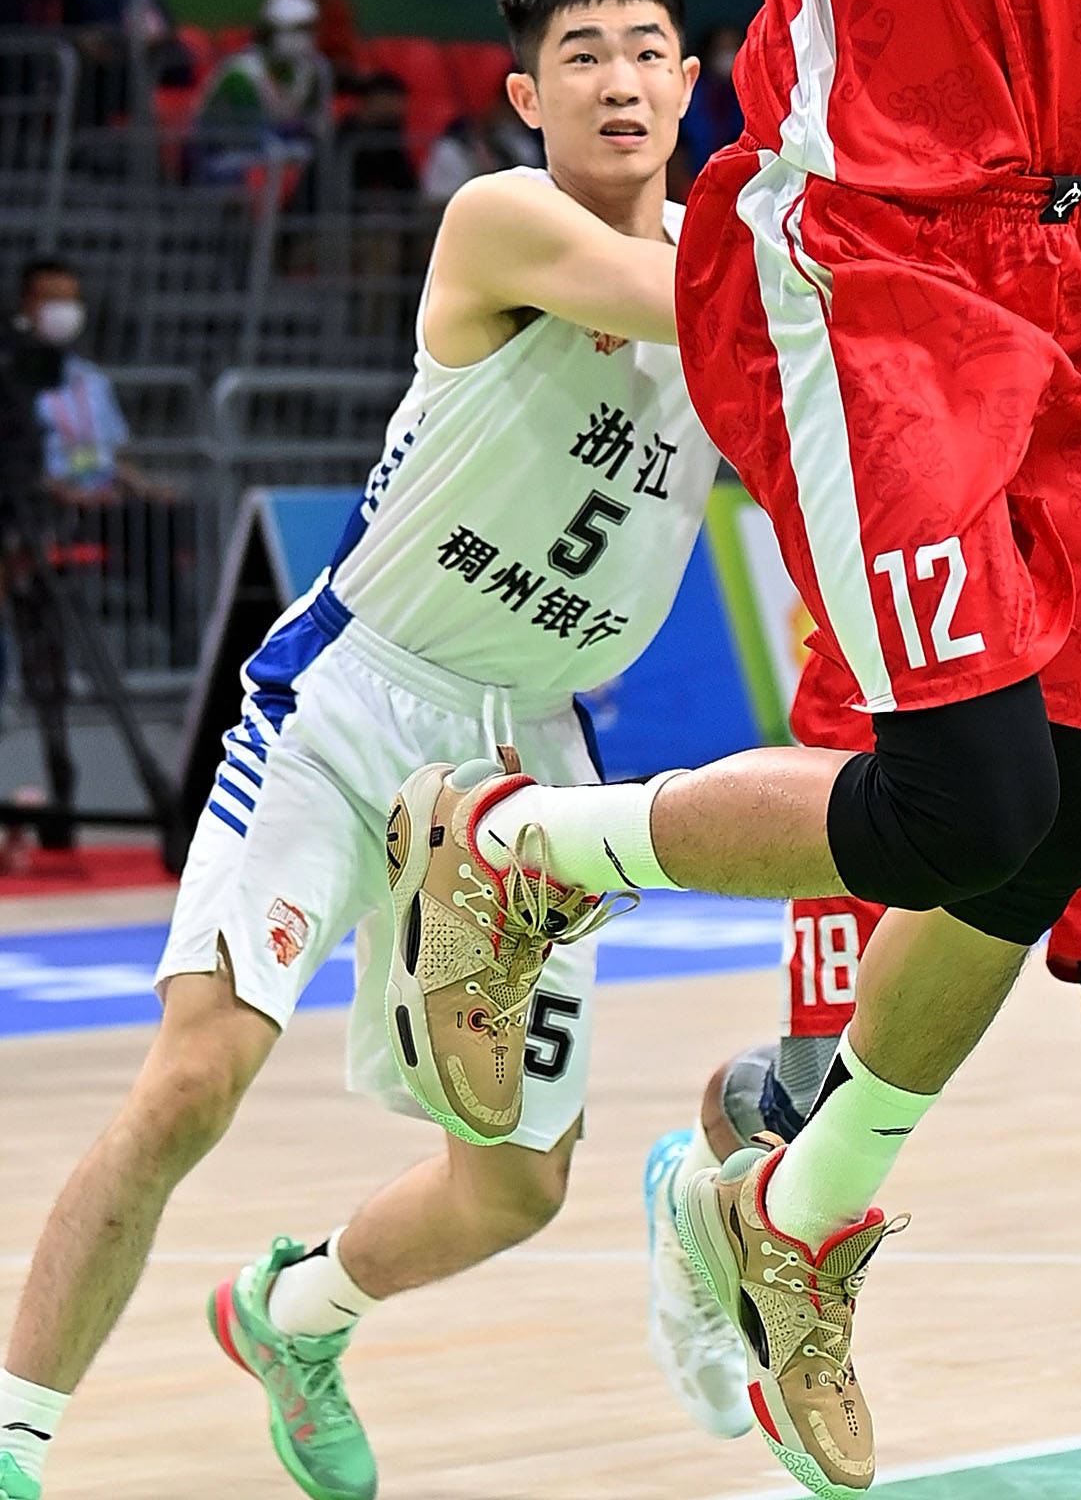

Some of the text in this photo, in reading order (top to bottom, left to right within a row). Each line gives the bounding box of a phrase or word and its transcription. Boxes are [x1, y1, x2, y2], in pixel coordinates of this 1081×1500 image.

[568, 402, 678, 500] 浙江
[547, 488, 632, 579] 5
[437, 524, 630, 650] 稠州银行
[873, 536, 986, 669] 12
[794, 912, 861, 1006] 18
[523, 989, 583, 1083] 5
